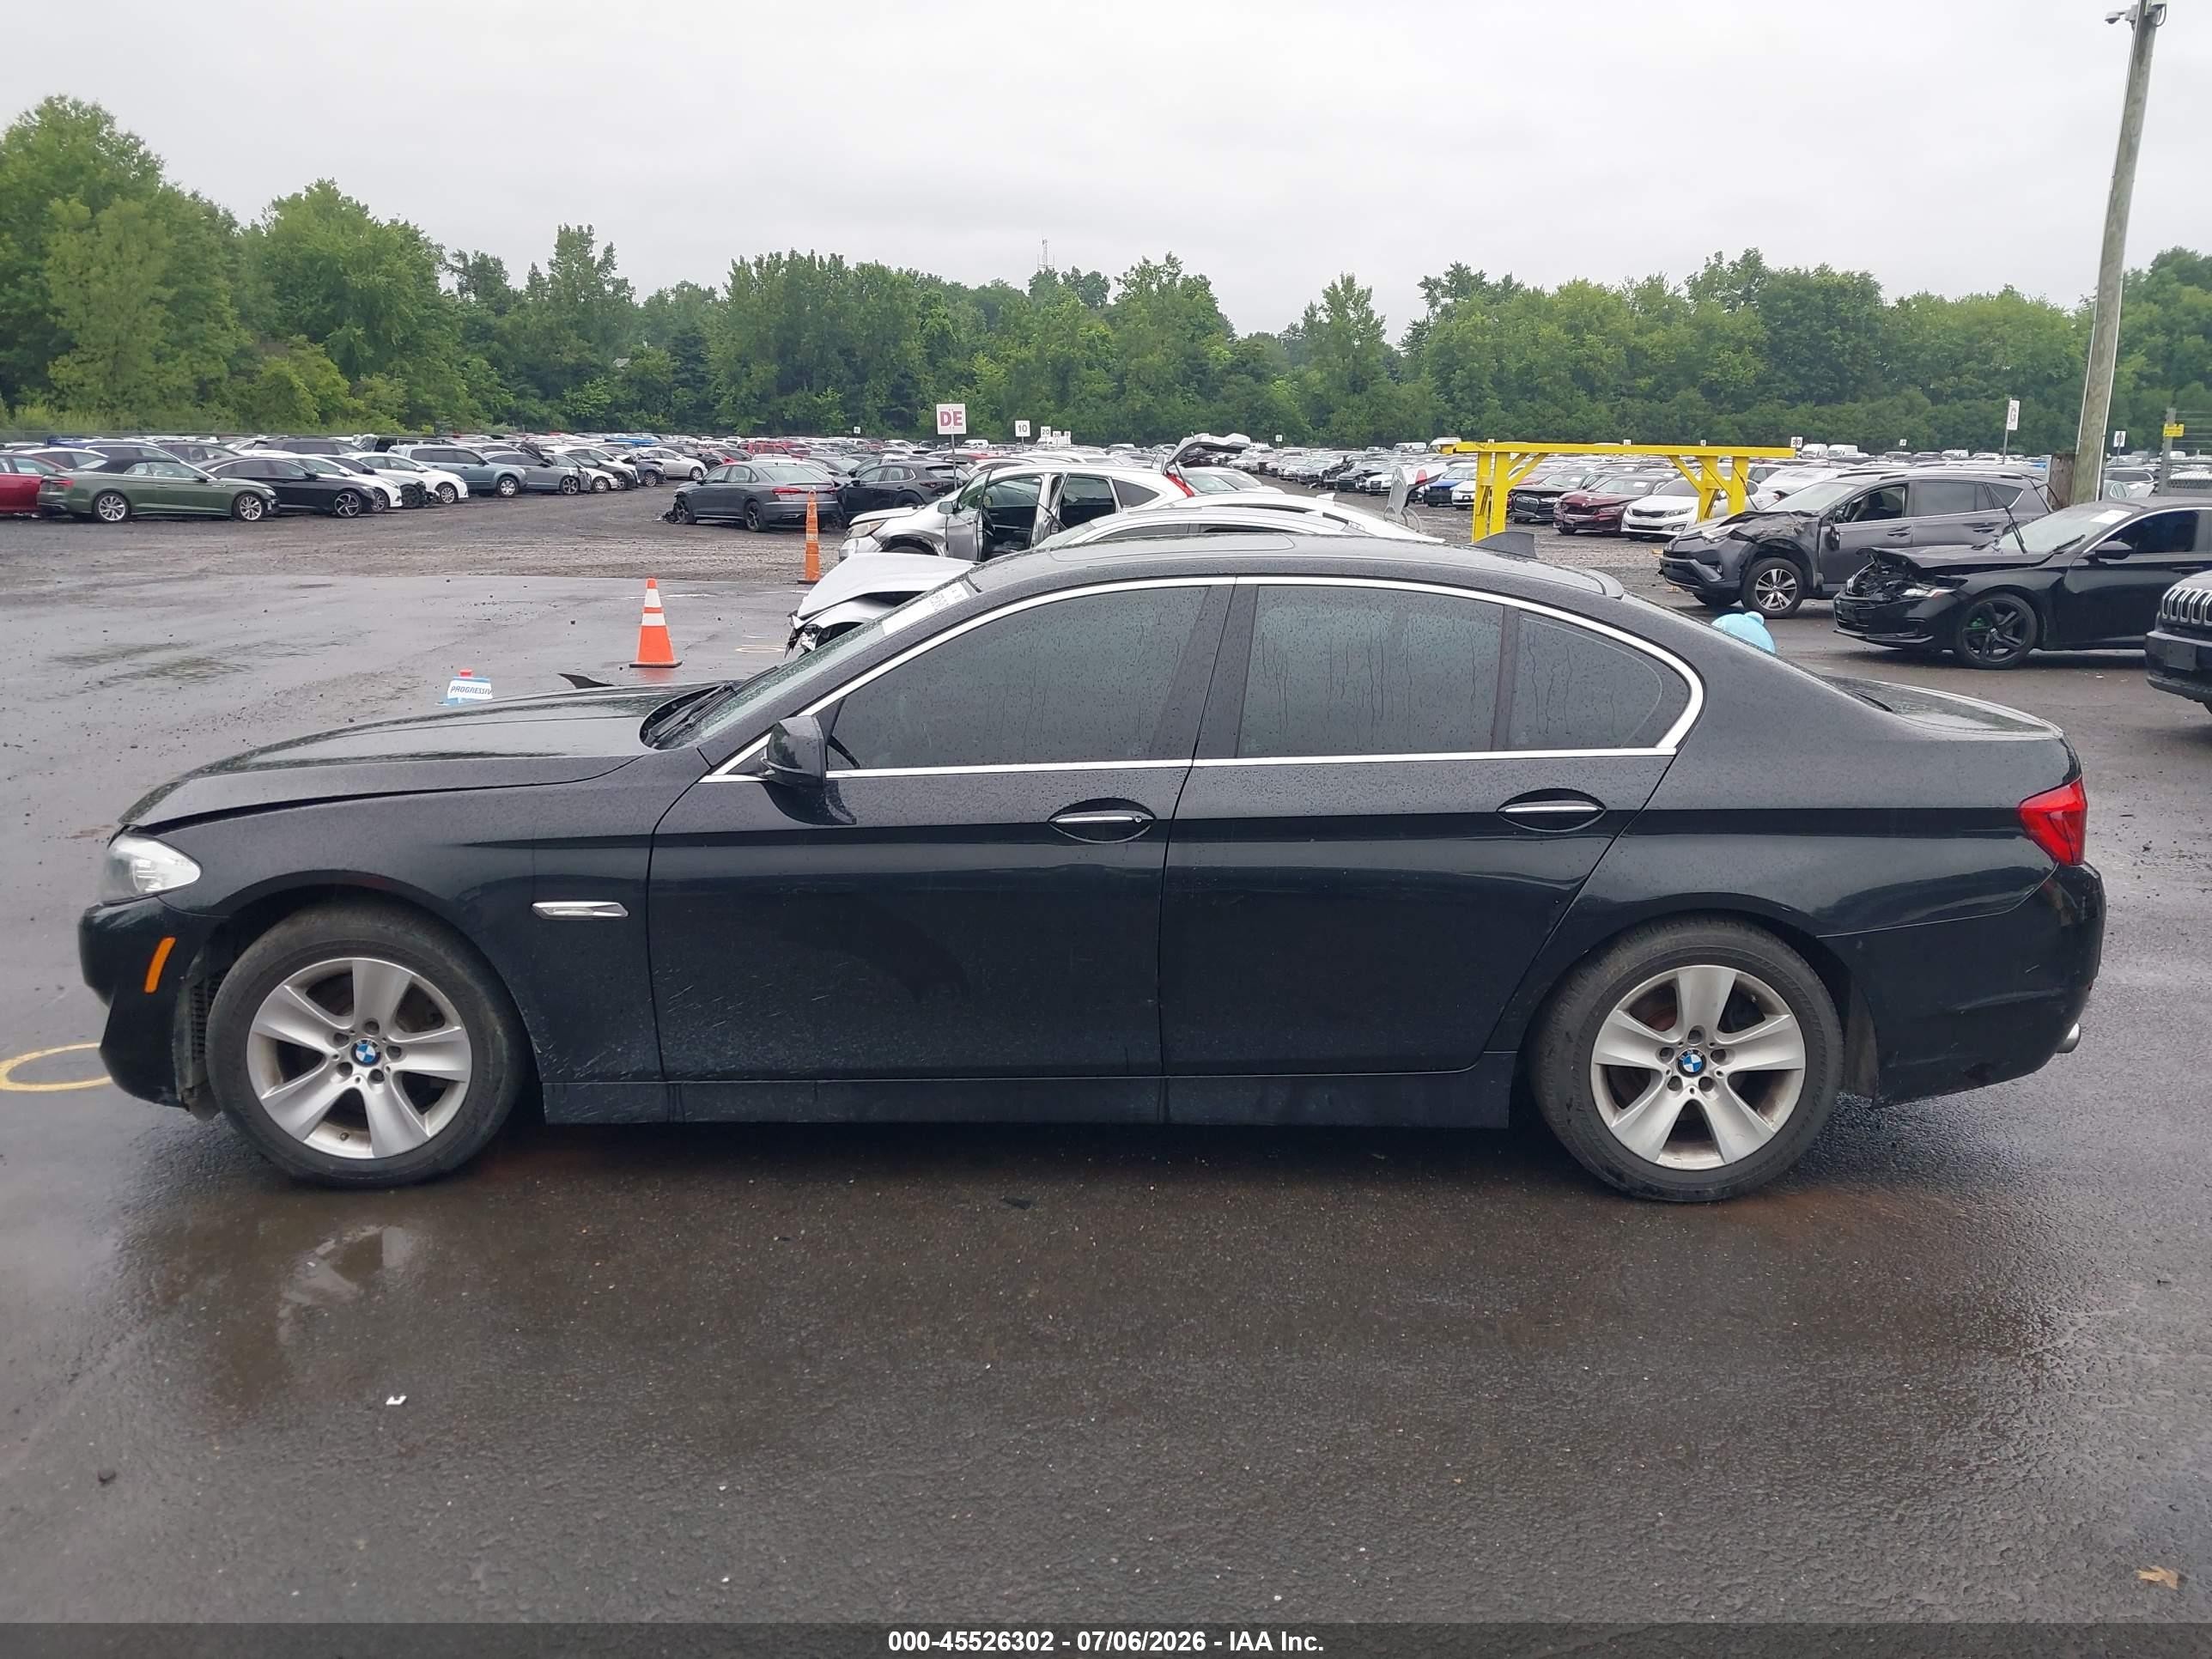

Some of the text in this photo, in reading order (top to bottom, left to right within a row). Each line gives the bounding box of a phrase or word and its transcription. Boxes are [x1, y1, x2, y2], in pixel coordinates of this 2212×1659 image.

[939, 410, 963, 427] DE
[2009, 407, 2017, 422] G
[1018, 424, 1028, 433] 10
